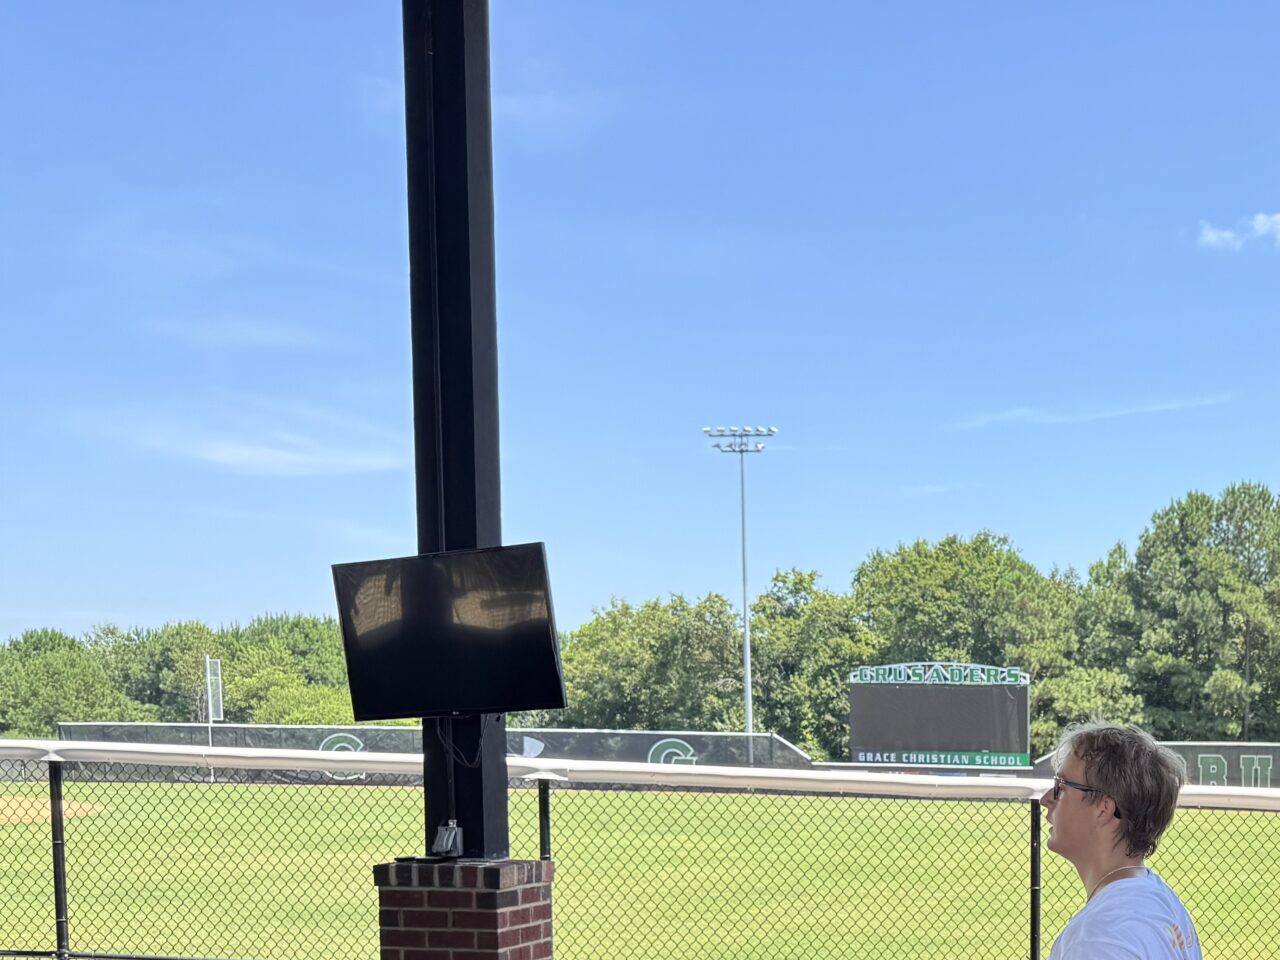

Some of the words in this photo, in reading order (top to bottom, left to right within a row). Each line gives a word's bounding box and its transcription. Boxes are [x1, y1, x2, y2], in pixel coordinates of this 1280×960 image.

[858, 666, 1021, 684] CRUSADERS
[858, 752, 897, 763] GRACE
[902, 753, 969, 764] CHRISTIAN
[975, 755, 1022, 766] SCHOOL
